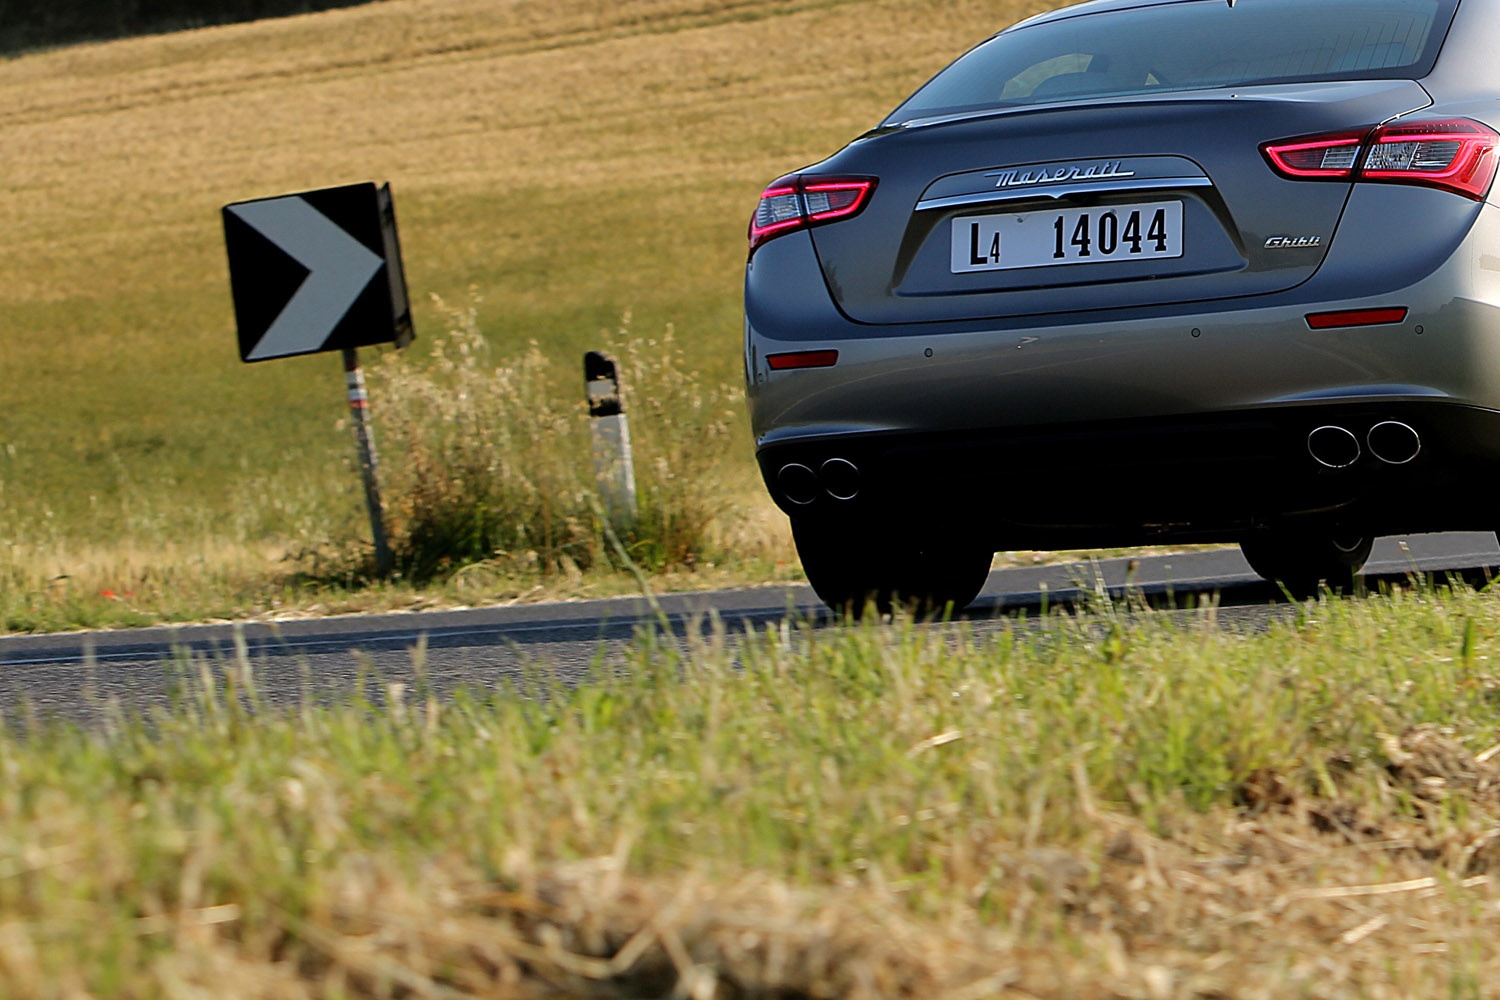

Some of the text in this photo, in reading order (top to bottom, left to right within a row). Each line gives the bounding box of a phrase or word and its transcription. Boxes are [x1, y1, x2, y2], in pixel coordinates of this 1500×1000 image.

[984, 161, 1134, 187] Maserati
[1053, 208, 1167, 258] 14044
[1264, 235, 1320, 249] Ghibli
